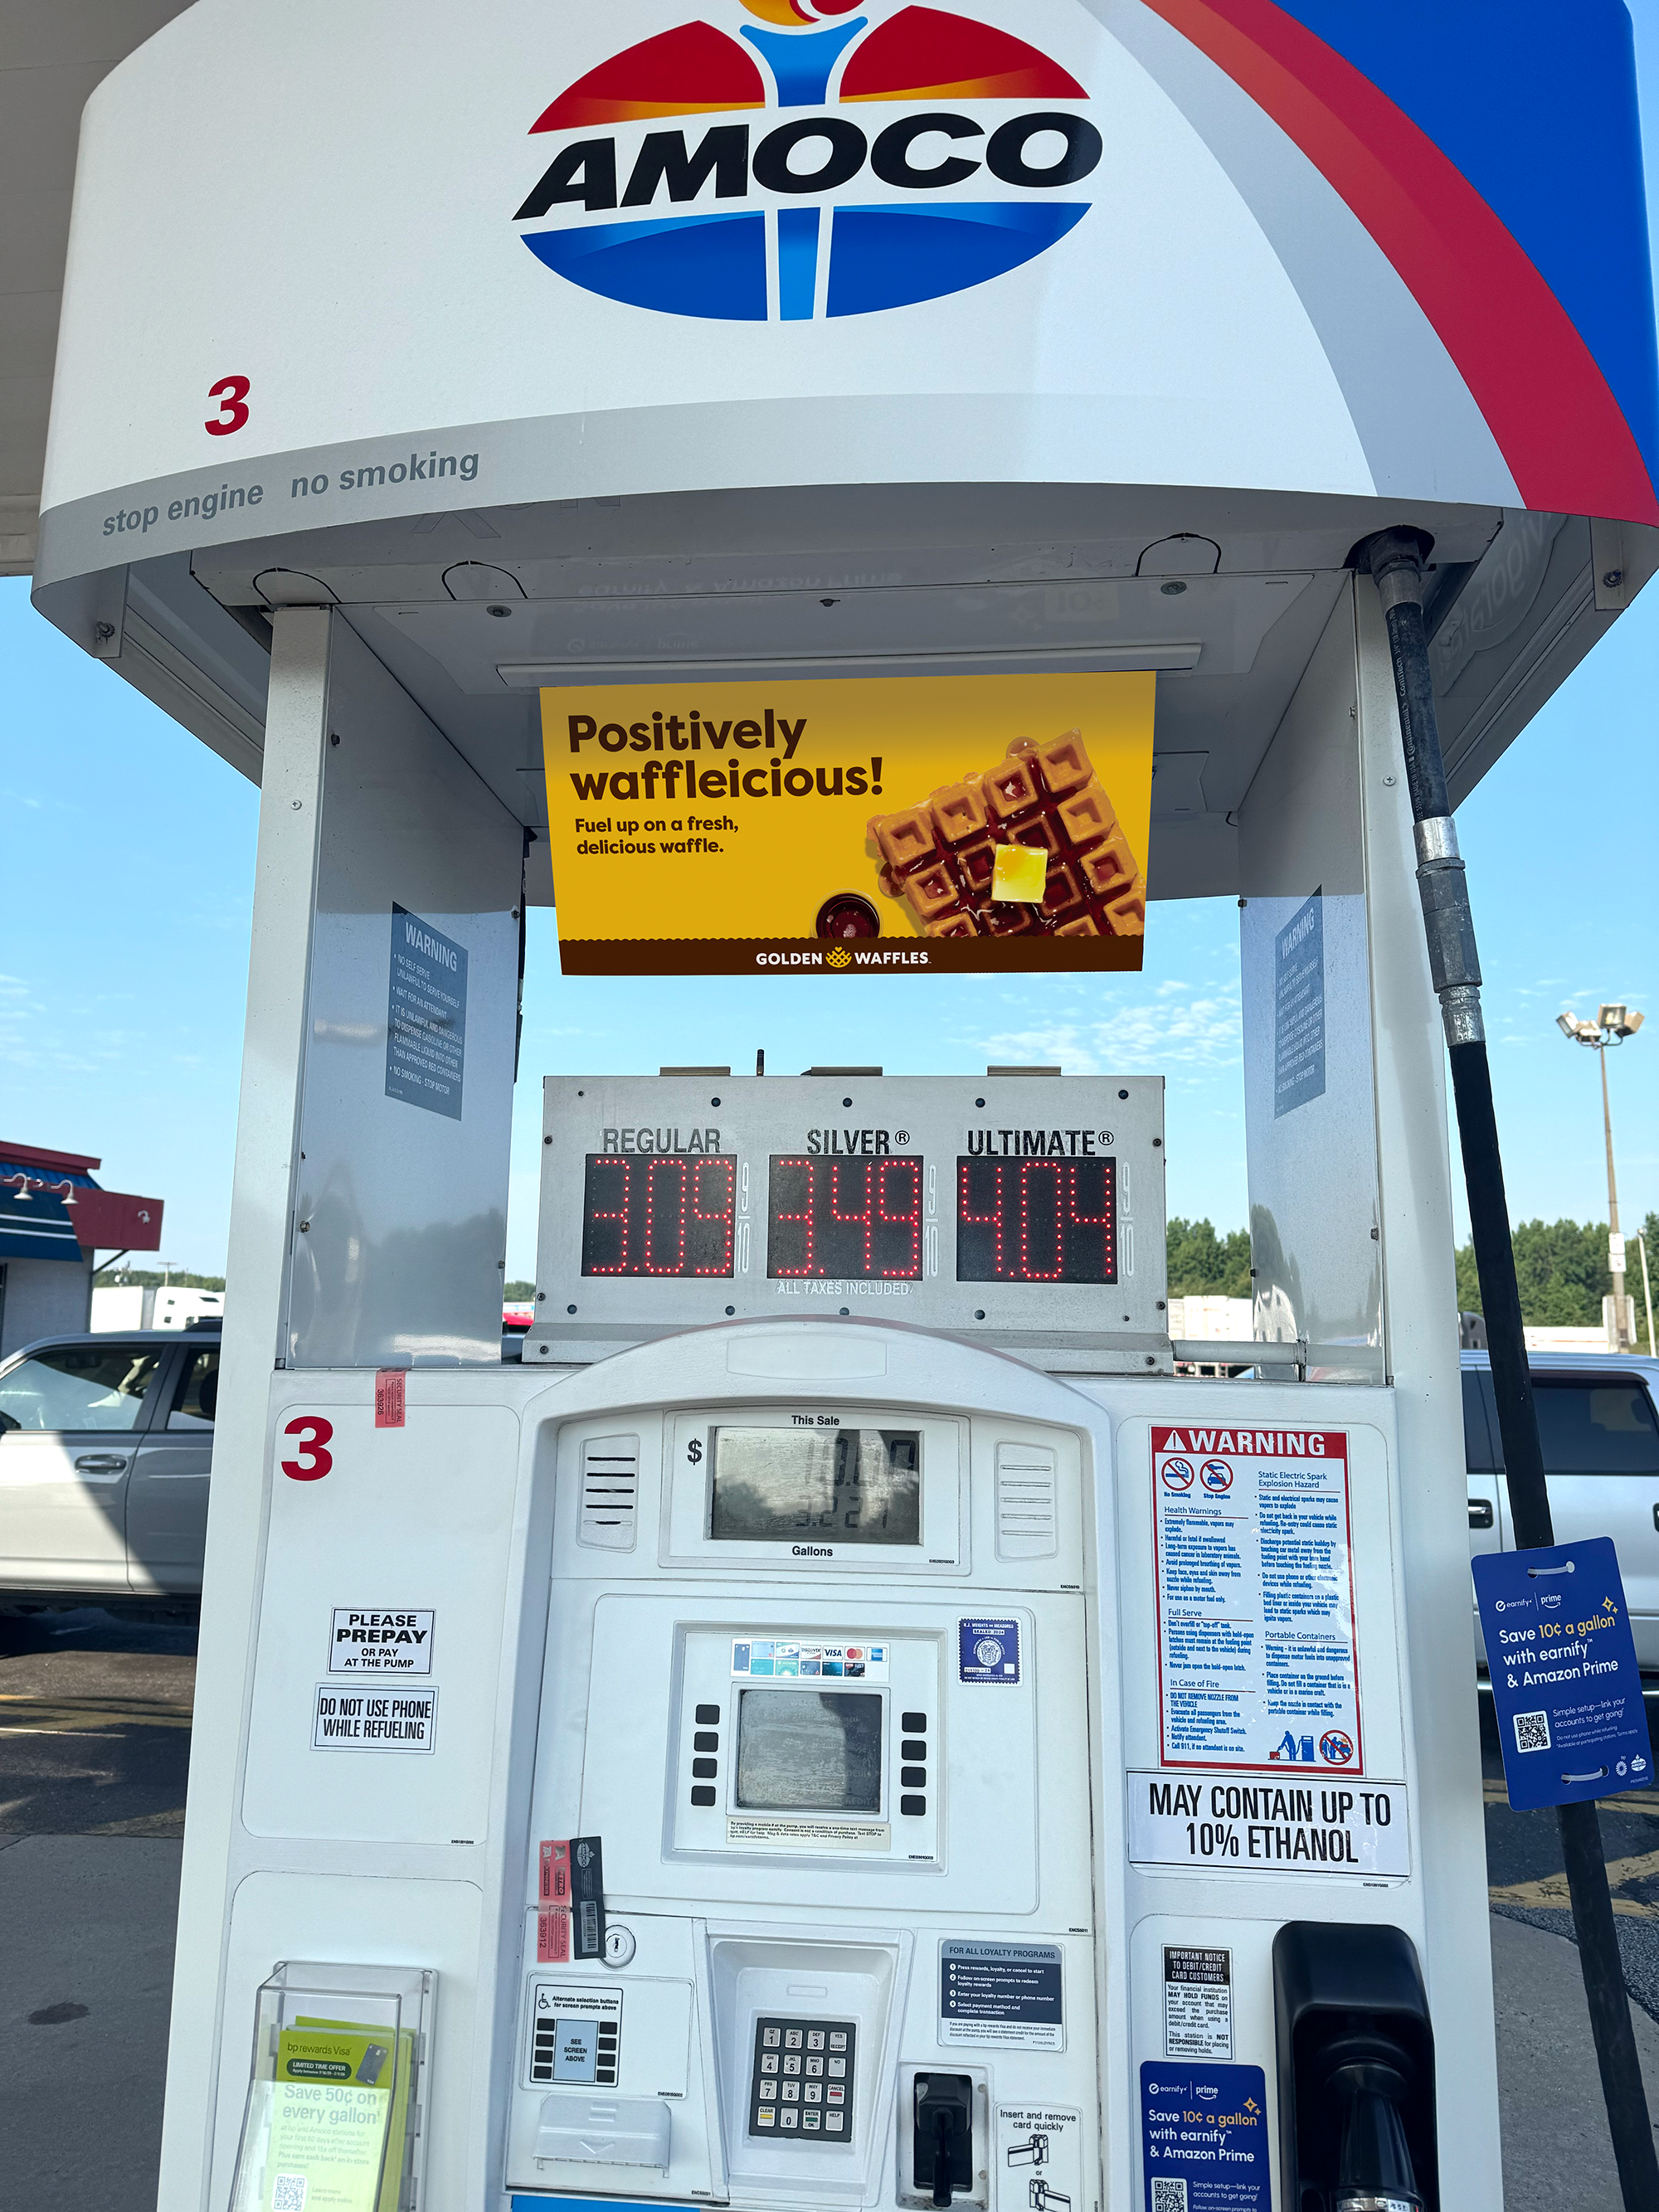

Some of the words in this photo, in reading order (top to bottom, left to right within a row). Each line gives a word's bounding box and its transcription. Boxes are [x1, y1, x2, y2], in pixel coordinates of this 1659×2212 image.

[512, 112, 1102, 221] AMOCO
[204, 376, 250, 435] 3
[291, 474, 328, 498] no
[339, 450, 479, 490] smoking
[102, 504, 158, 536] stop
[167, 482, 264, 522] engine
[568, 709, 807, 759] Positively
[570, 757, 883, 800] waffleicious!
[575, 818, 611, 833] Fuel
[616, 822, 640, 835] up
[644, 819, 666, 831] on
[671, 819, 682, 831] a
[688, 815, 738, 833] fresh,
[577, 840, 655, 854] delicious
[660, 838, 724, 853] waffle.
[1282, 908, 1314, 960] WARNING
[406, 921, 457, 971] WARNING
[756, 953, 823, 965] GOLDEN
[854, 952, 928, 964] WAFFLES
[398, 954, 405, 965] NO
[406, 959, 416, 971] SELF
[416, 965, 430, 980] SERVE
[394, 1066, 401, 1076] NO
[401, 1069, 421, 1084] SMOKING
[425, 1078, 435, 1089] STOP
[435, 1082, 450, 1095] MOTOR
[603, 1128, 721, 1154] REGULAR
[777, 1281, 800, 1295] ALL
[803, 1281, 842, 1295] TAXES
[846, 1281, 911, 1296] INCLUDED
[791, 1415, 815, 1425] This
[817, 1416, 839, 1426] Sale
[280, 1416, 333, 1480] 3
[1189, 1430, 1326, 1456] WARNING
[687, 1438, 703, 1466] $
[1259, 1480, 1293, 1488] Explosion
[1306, 1472, 1327, 1481] Spark
[1189, 1508, 1222, 1516] Warnings
[792, 1546, 833, 1558] Gallons
[1541, 1594, 1561, 1605] prime
[349, 1614, 416, 1626] PLEASE
[337, 1629, 427, 1644] PREPAY
[1499, 1630, 1535, 1644] Save
[1539, 1623, 1562, 1638] 10¢
[1565, 1624, 1574, 1634] a
[1577, 1615, 1615, 1636] gallon
[362, 1648, 375, 1656] OR
[824, 1649, 842, 1657] VISA
[1503, 1648, 1535, 1665] with
[362, 1659, 381, 1667] THE
[384, 1660, 414, 1668] PUMP
[1507, 1674, 1518, 1688] &
[1523, 1667, 1580, 1686] Amazon
[1583, 1660, 1618, 1676] Prime
[320, 1698, 336, 1715] DO
[339, 1699, 363, 1716] NOT
[367, 1699, 389, 1717] USE
[392, 1700, 431, 1719] PHONE
[324, 1719, 361, 1737] WHILE
[363, 1720, 425, 1739] REFUELING
[1150, 1783, 1202, 1817] MAY
[1211, 1786, 1313, 1822] CONTAIN
[1321, 1791, 1353, 1824] UP
[1360, 1792, 1390, 1826] TO
[1187, 1822, 1239, 1857] 10%
[1248, 1826, 1359, 1863] ETHANOL
[1014, 1951, 1055, 1959] PROGRAMS
[1170, 1951, 1203, 1960] IMPORTANT
[1204, 1953, 1225, 1962] NOTICE
[1173, 1961, 1180, 1969] TO
[1183, 1962, 1222, 1971] DEBIT/CREDIT
[1172, 1971, 1187, 1980] CARD
[1190, 1972, 1224, 1981] CUSTOMERS
[287, 2043, 298, 2052] bp
[299, 2045, 332, 2054] rewards
[813, 2039, 819, 2047] 3
[766, 2062, 772, 2070] 4
[790, 2064, 795, 2072] 5
[285, 2084, 322, 2100] Save
[325, 2087, 353, 2106] 50¢
[357, 2093, 377, 2105] on
[766, 2088, 771, 2097] 7
[788, 2090, 793, 2098] 8
[810, 2092, 815, 2100] 9
[1160, 2086, 1184, 2094] earnify
[1196, 2086, 1219, 2095] prime
[283, 2107, 326, 2123] every
[786, 2117, 791, 2125] 0
[1000, 2110, 1024, 2118] Insert
[1149, 2109, 1180, 2122] Save
[1183, 2111, 1203, 2122] 10¢
[1206, 2115, 1214, 2124] a
[1219, 2112, 1257, 2128] gallon
[1034, 2122, 1063, 2132] quickly
[1149, 2127, 1177, 2140] with
[1150, 2146, 1159, 2157] &
[1163, 2146, 1215, 2160] Amazon
[1219, 2149, 1254, 2162] Prime
